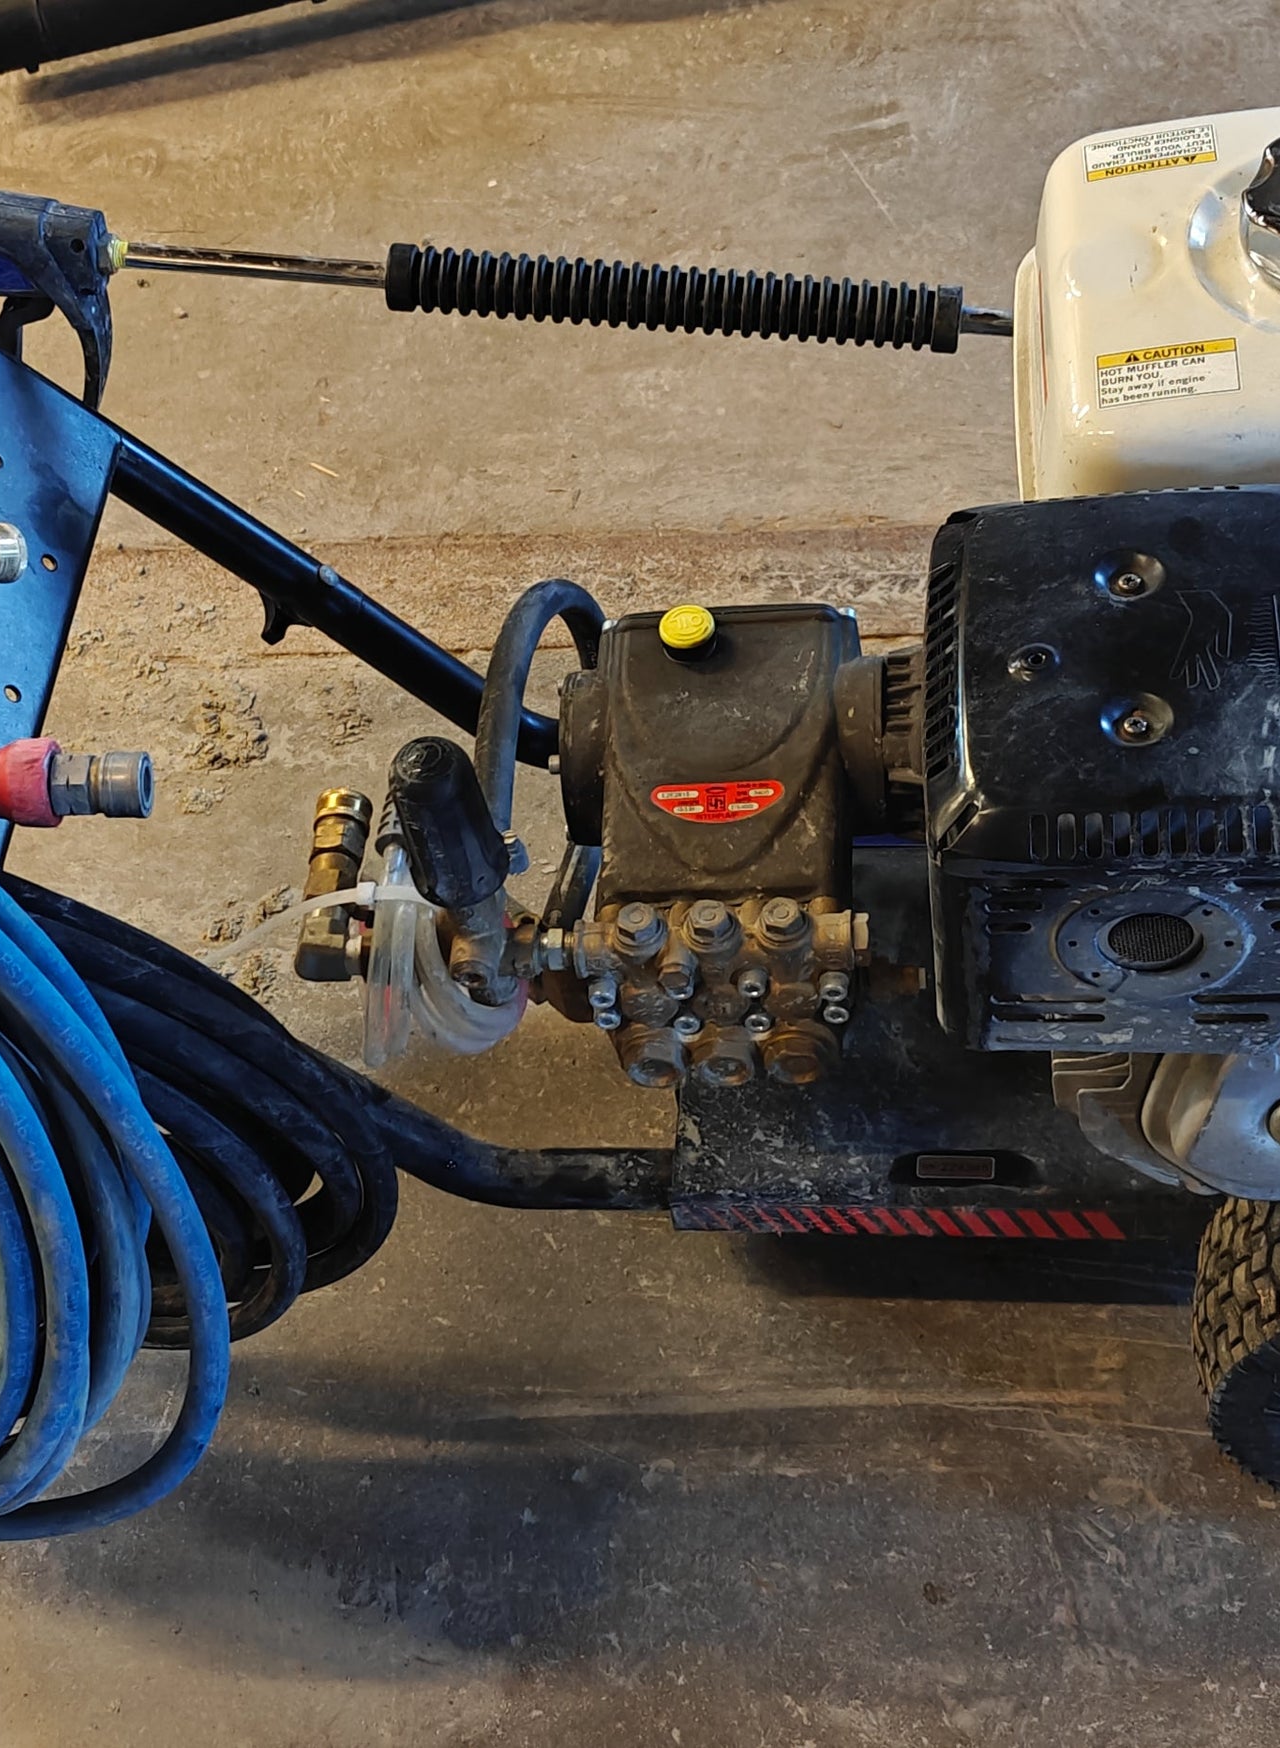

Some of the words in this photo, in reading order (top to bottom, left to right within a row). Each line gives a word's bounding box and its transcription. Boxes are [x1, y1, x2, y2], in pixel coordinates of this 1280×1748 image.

[1156, 129, 1195, 140] MOTEUR
[1118, 141, 1151, 152] QUAND
[1154, 144, 1181, 153] VOUS
[1186, 138, 1212, 148] PEUT
[1091, 159, 1126, 169] CHAUD
[1105, 158, 1180, 176] ATTENTION
[1143, 345, 1205, 360] CAUTION
[1101, 368, 1122, 377] HOT
[1127, 361, 1177, 373] MUFFLER
[1182, 357, 1205, 365] CAN
[1101, 386, 1124, 396] Stay
[1128, 382, 1154, 392] away
[1158, 378, 1164, 386] if
[1169, 375, 1205, 385] engine
[1102, 375, 1133, 386] BURN
[1102, 397, 1120, 405] has
[1123, 391, 1149, 401] been
[1152, 386, 1197, 396] running.
